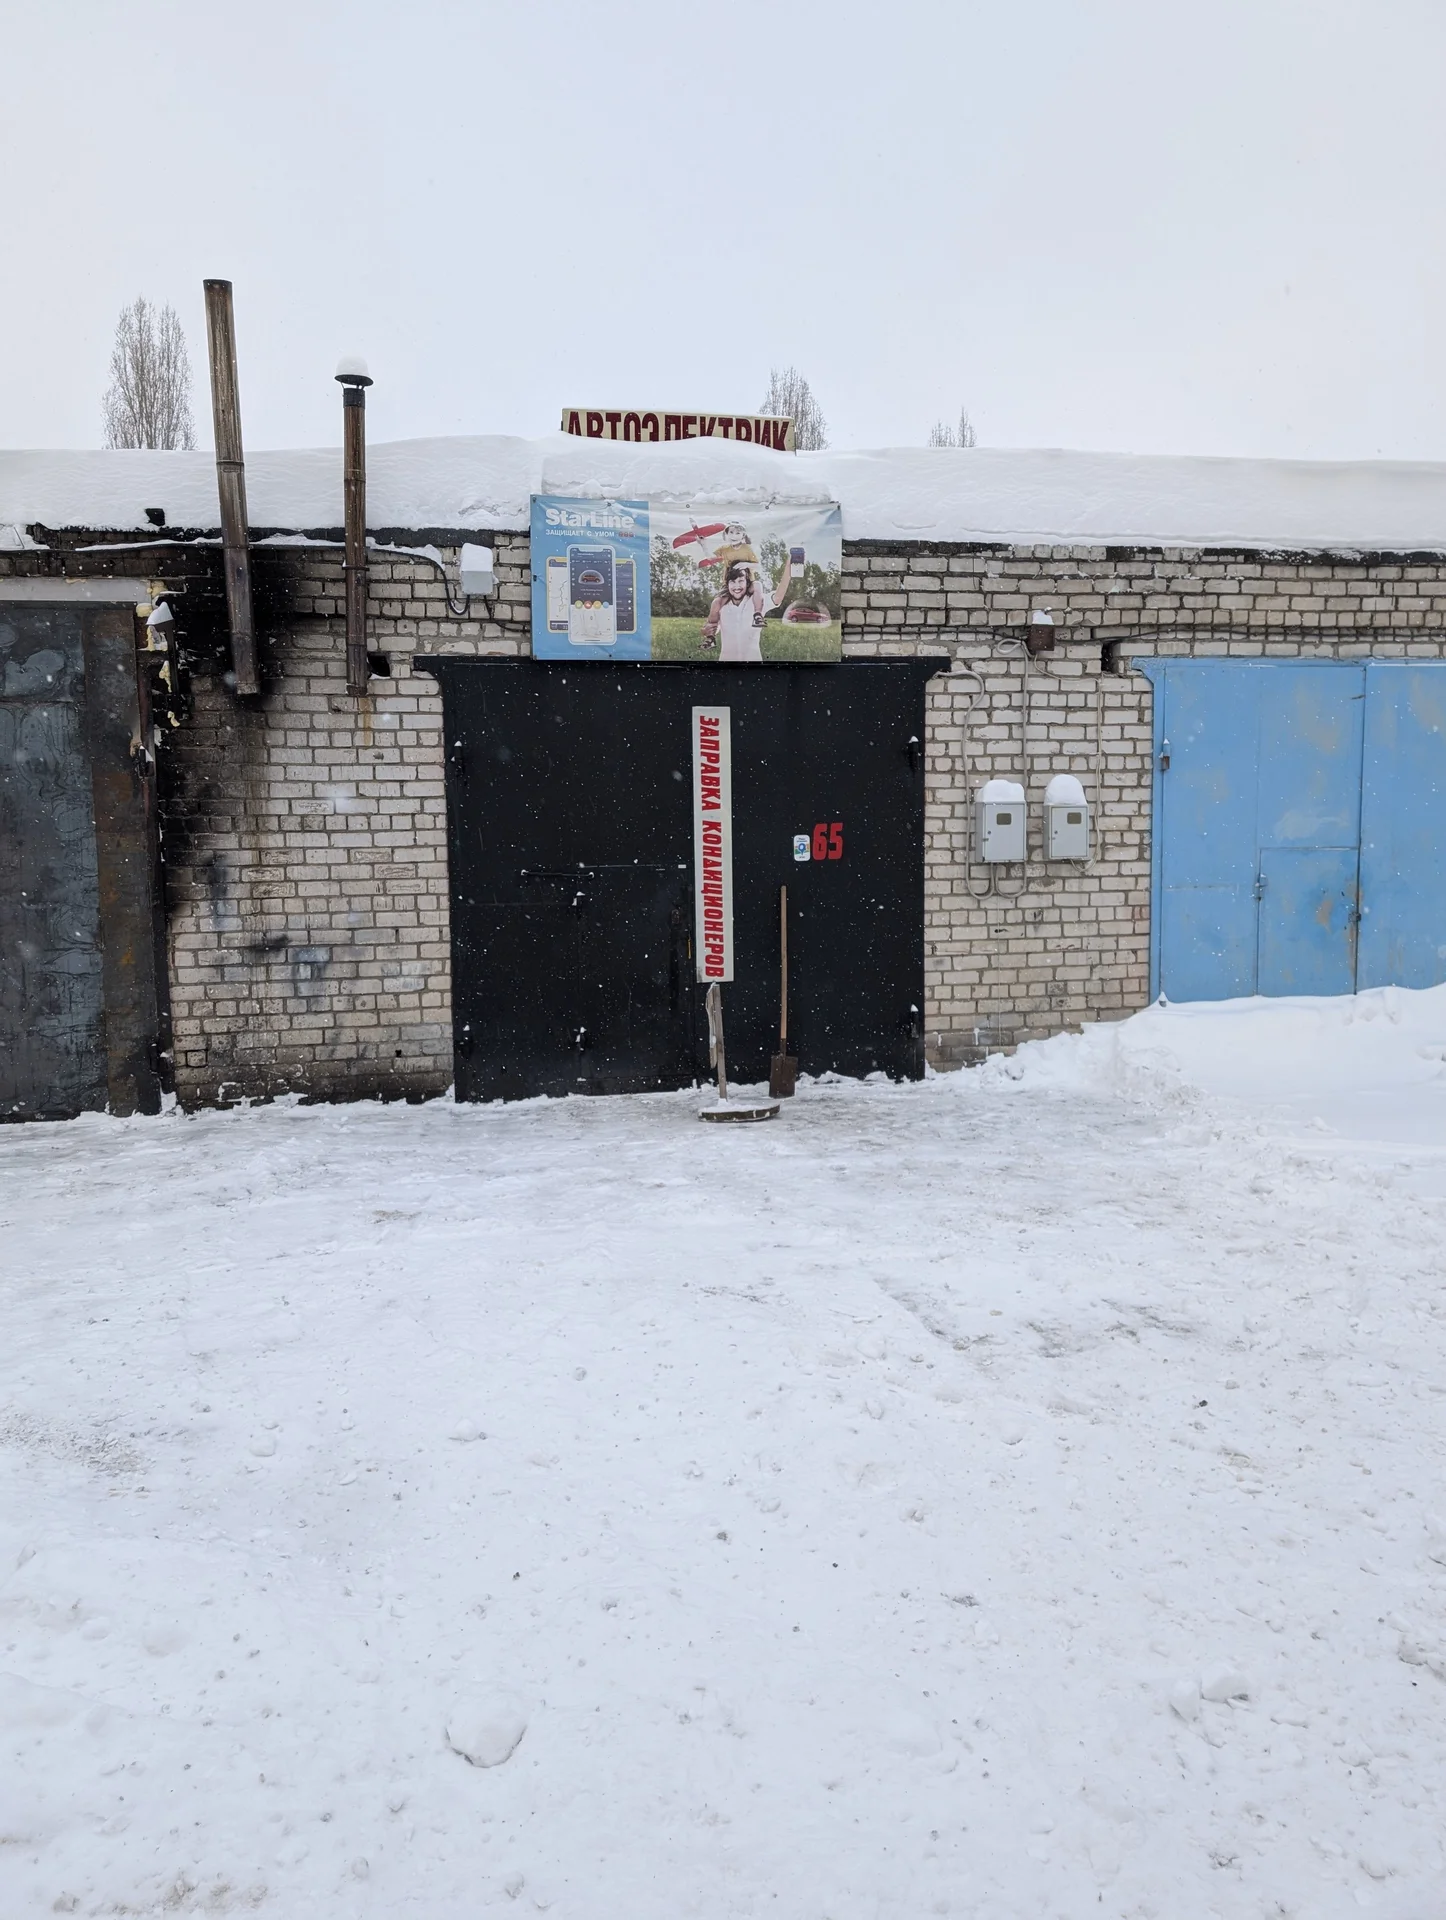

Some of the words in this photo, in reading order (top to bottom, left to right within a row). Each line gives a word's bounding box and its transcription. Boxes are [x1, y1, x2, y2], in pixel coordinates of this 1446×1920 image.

[568, 411, 789, 451] АВТОЭЛЕКТРИК
[545, 508, 635, 529] StarLine
[700, 715, 721, 811] ЗАПРАВКА
[812, 823, 843, 860] 65
[701, 820, 724, 978] КОНДИЦИОНЕРОВ
